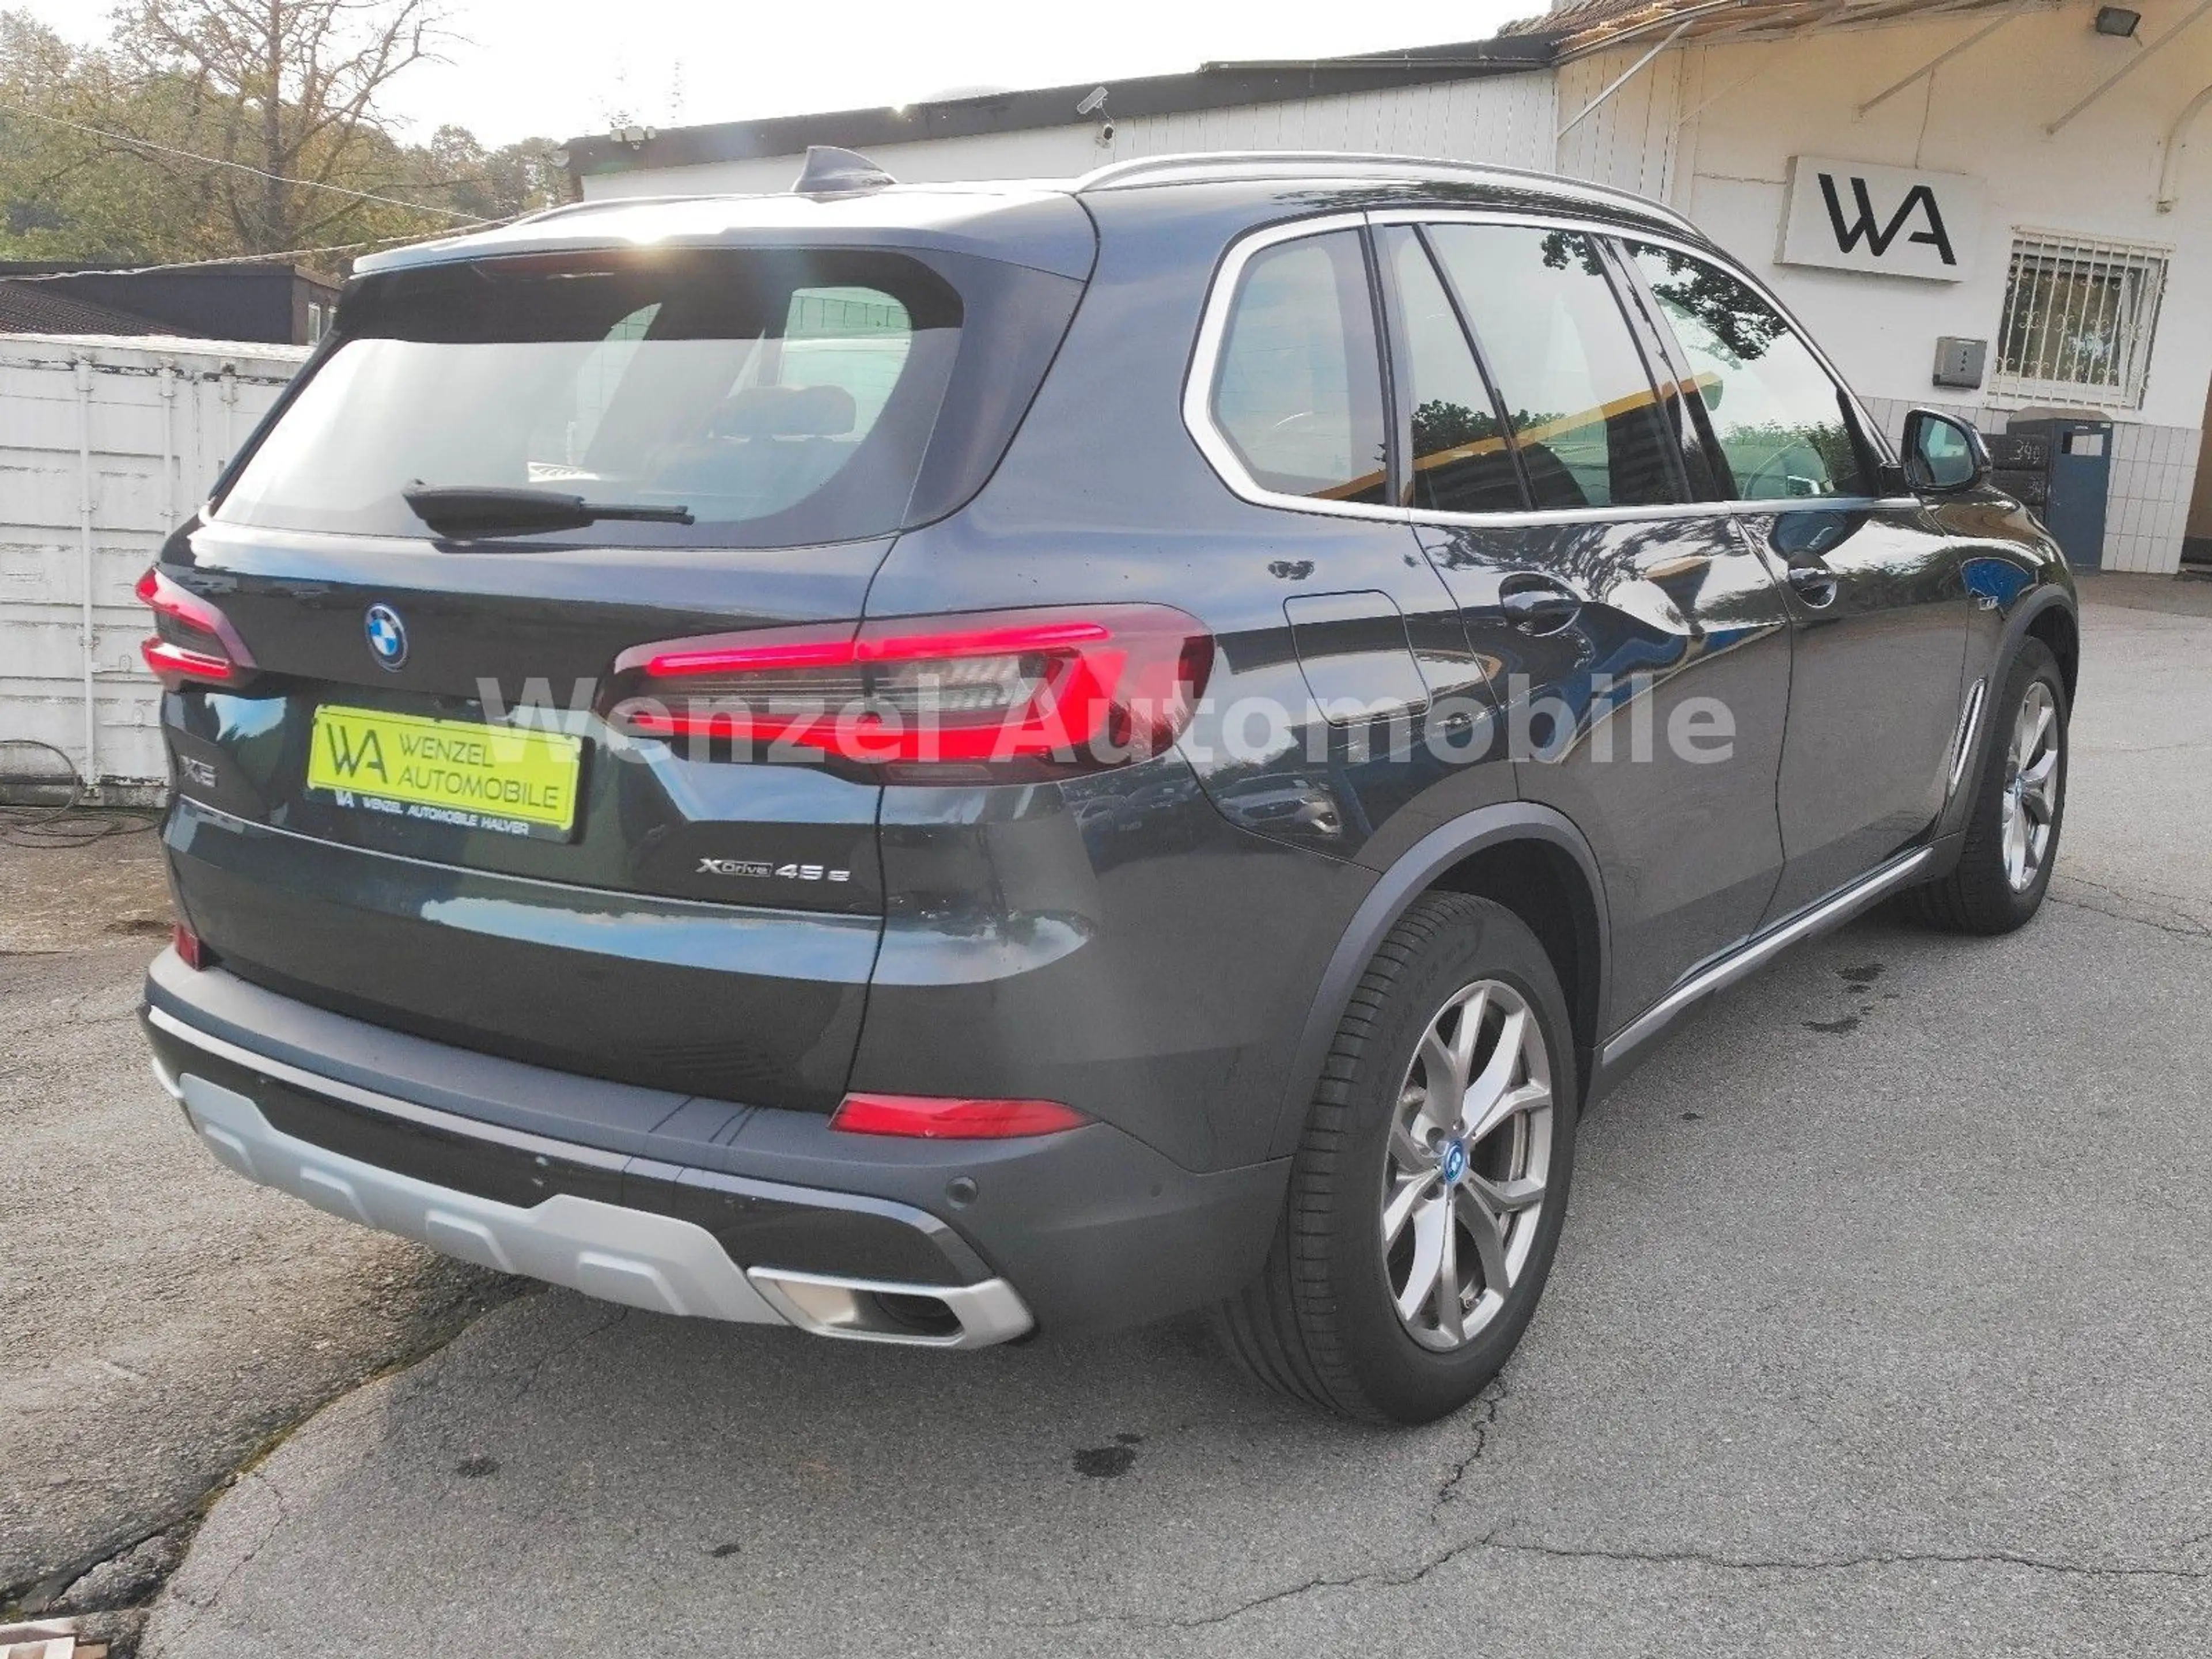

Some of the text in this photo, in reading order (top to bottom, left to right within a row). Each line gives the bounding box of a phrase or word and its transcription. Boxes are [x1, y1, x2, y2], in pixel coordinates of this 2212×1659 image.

[1818, 172, 1957, 265] WA
[327, 722, 388, 784] WA
[399, 733, 494, 768] WENZEL
[397, 766, 560, 809] AUTOMOBILE
[407, 804, 478, 827] AUTOMOBILE
[481, 816, 529, 836] HALVER
